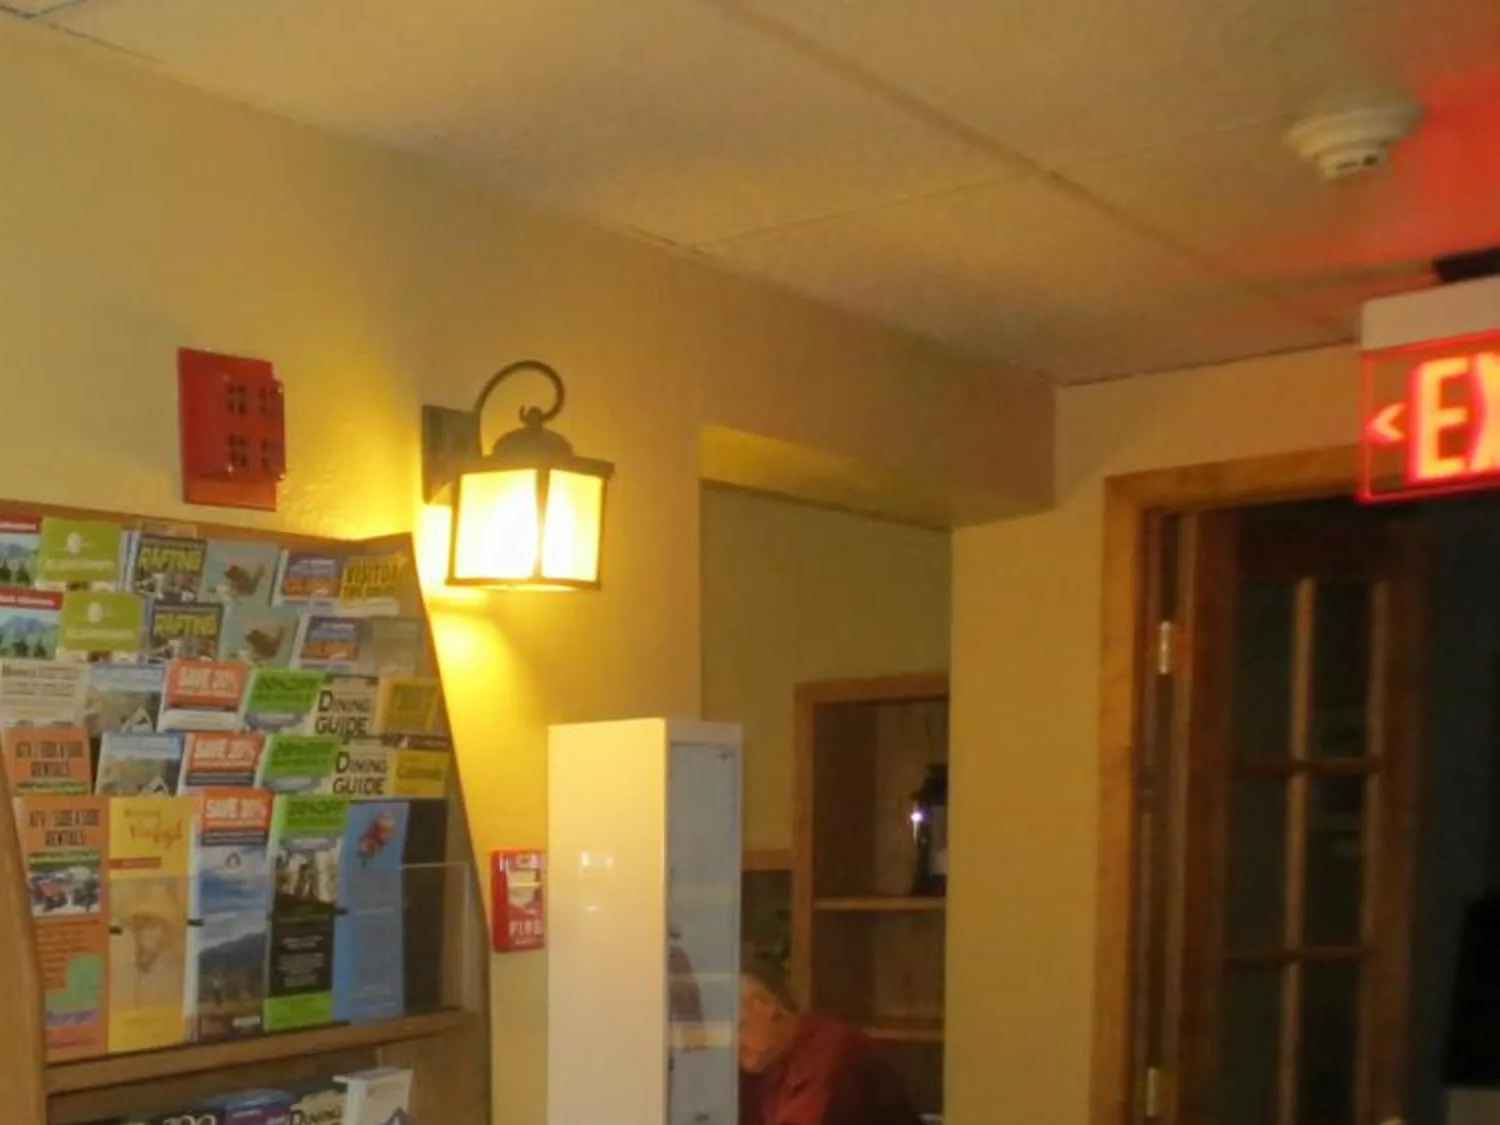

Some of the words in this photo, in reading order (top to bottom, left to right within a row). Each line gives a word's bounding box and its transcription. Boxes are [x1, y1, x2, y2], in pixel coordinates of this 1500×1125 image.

[139, 547, 202, 572] RAFTING
[154, 613, 217, 639] RAFTING
[315, 716, 368, 737] GUIDE
[335, 751, 388, 774] DINING
[332, 776, 385, 796] GUIDE
[206, 797, 238, 819] SAVE
